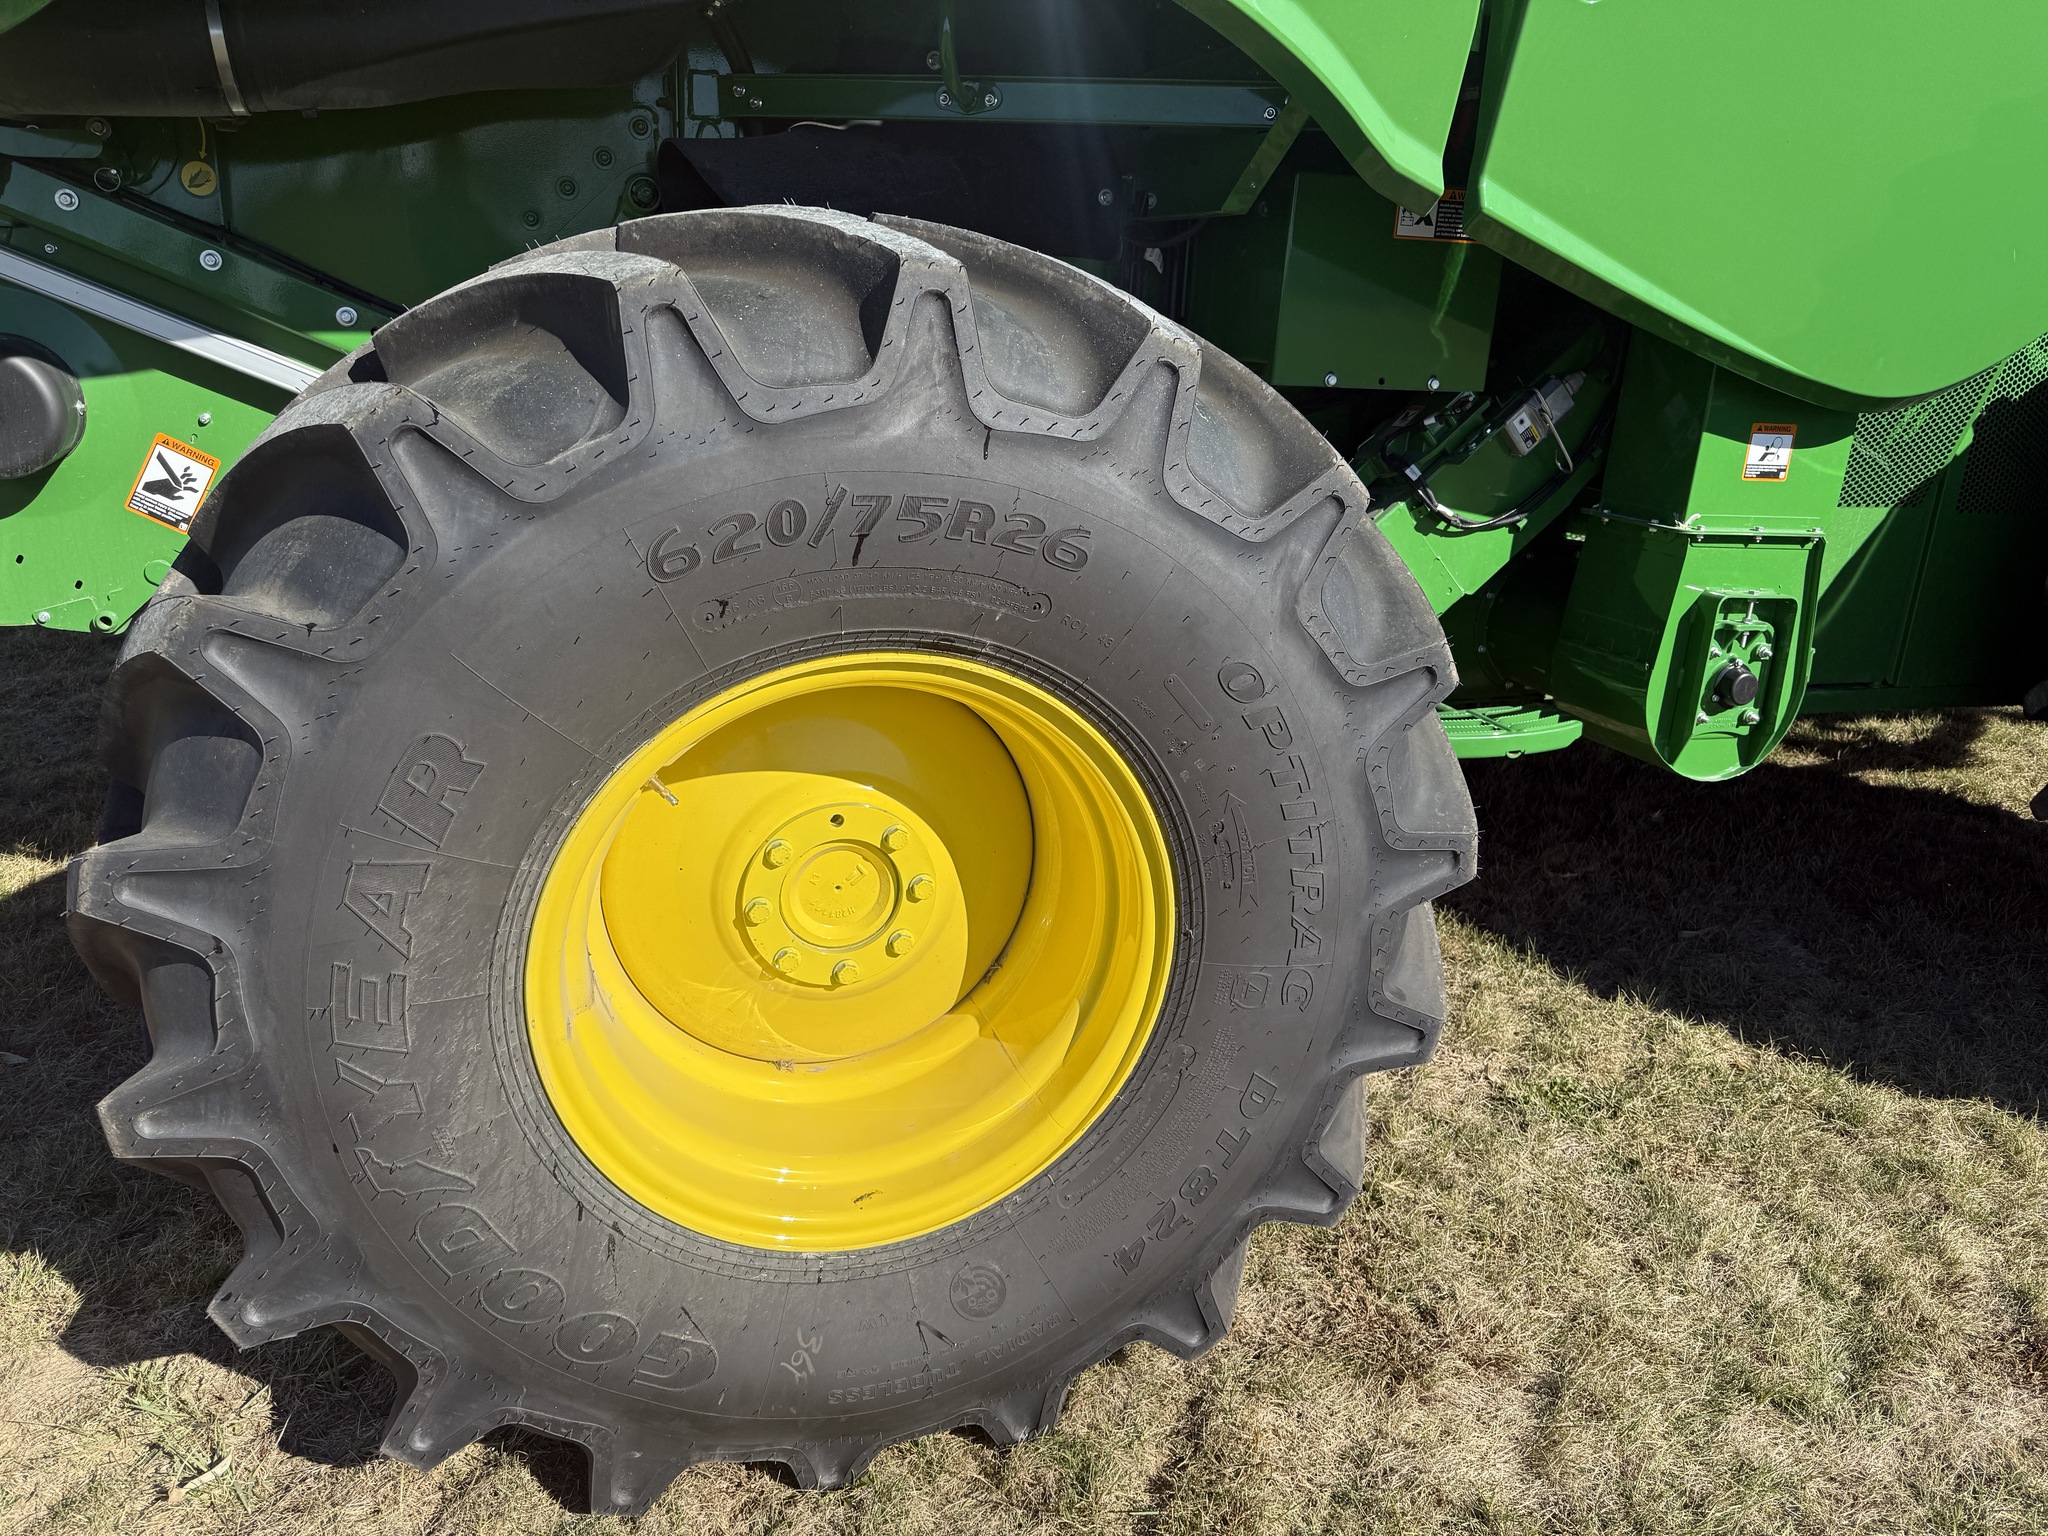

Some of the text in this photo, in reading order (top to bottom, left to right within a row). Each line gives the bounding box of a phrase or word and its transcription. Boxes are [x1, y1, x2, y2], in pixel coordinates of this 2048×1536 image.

[171, 441, 215, 467] WARNING
[1764, 425, 1791, 433] WARNING
[645, 484, 1093, 584] 620/75R26
[747, 594, 766, 608] A8
[827, 574, 849, 582] LOAD
[1218, 661, 1325, 1012] OPTITRAC
[1233, 827, 1257, 885] ROTATION
[331, 732, 719, 1394] GOODYEAR
[1113, 1072, 1277, 1276] DT824
[828, 1313, 1062, 1405] RADIAL TUBELESS
